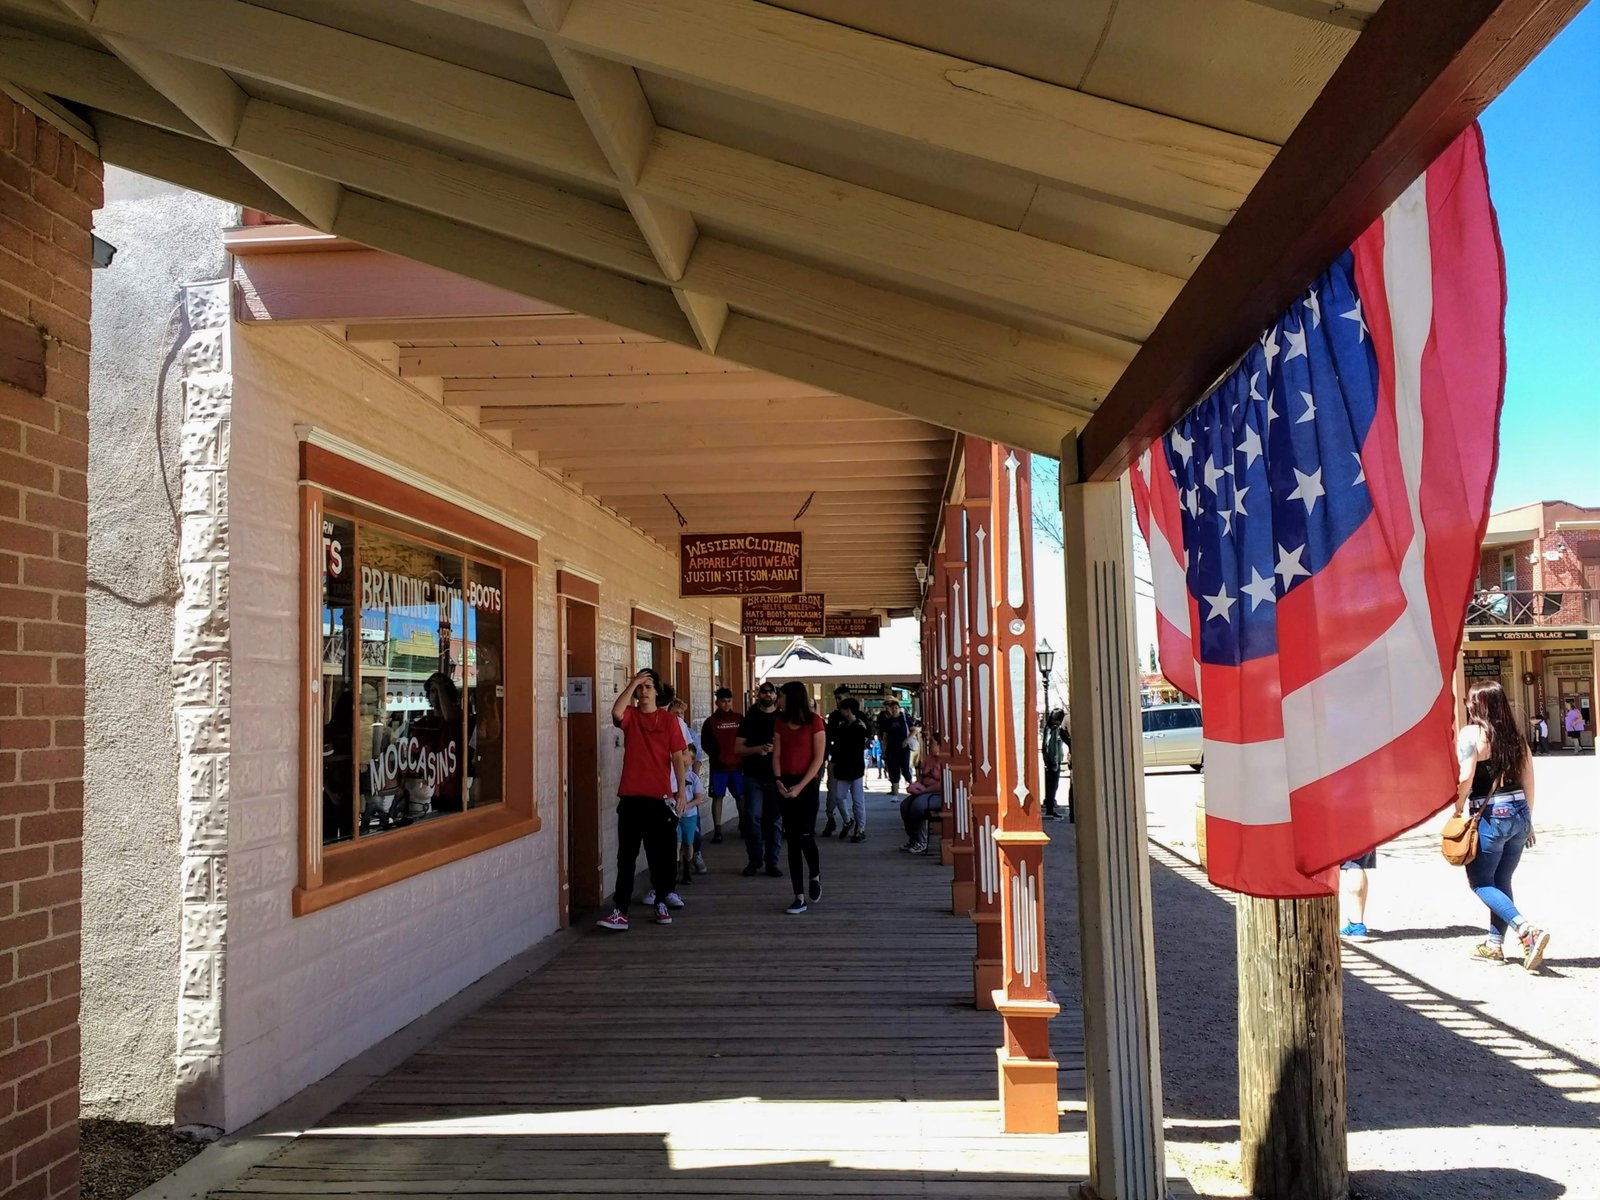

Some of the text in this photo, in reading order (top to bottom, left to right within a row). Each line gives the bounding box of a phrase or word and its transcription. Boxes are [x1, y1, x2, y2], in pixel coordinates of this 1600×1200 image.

[685, 536, 800, 557] WESTERN CLOTHING
[689, 557, 732, 569] APPAREL
[740, 555, 795, 568] FOOTWEAR
[725, 570, 768, 582] STETSON
[770, 569, 800, 581] ARIAT
[361, 566, 462, 625] BRANDING IRON
[747, 595, 822, 608] BRANDING IRON
[1503, 631, 1534, 639] CRYSTAL
[1535, 631, 1563, 639] PALACE
[370, 736, 457, 797] MOCCASINS
